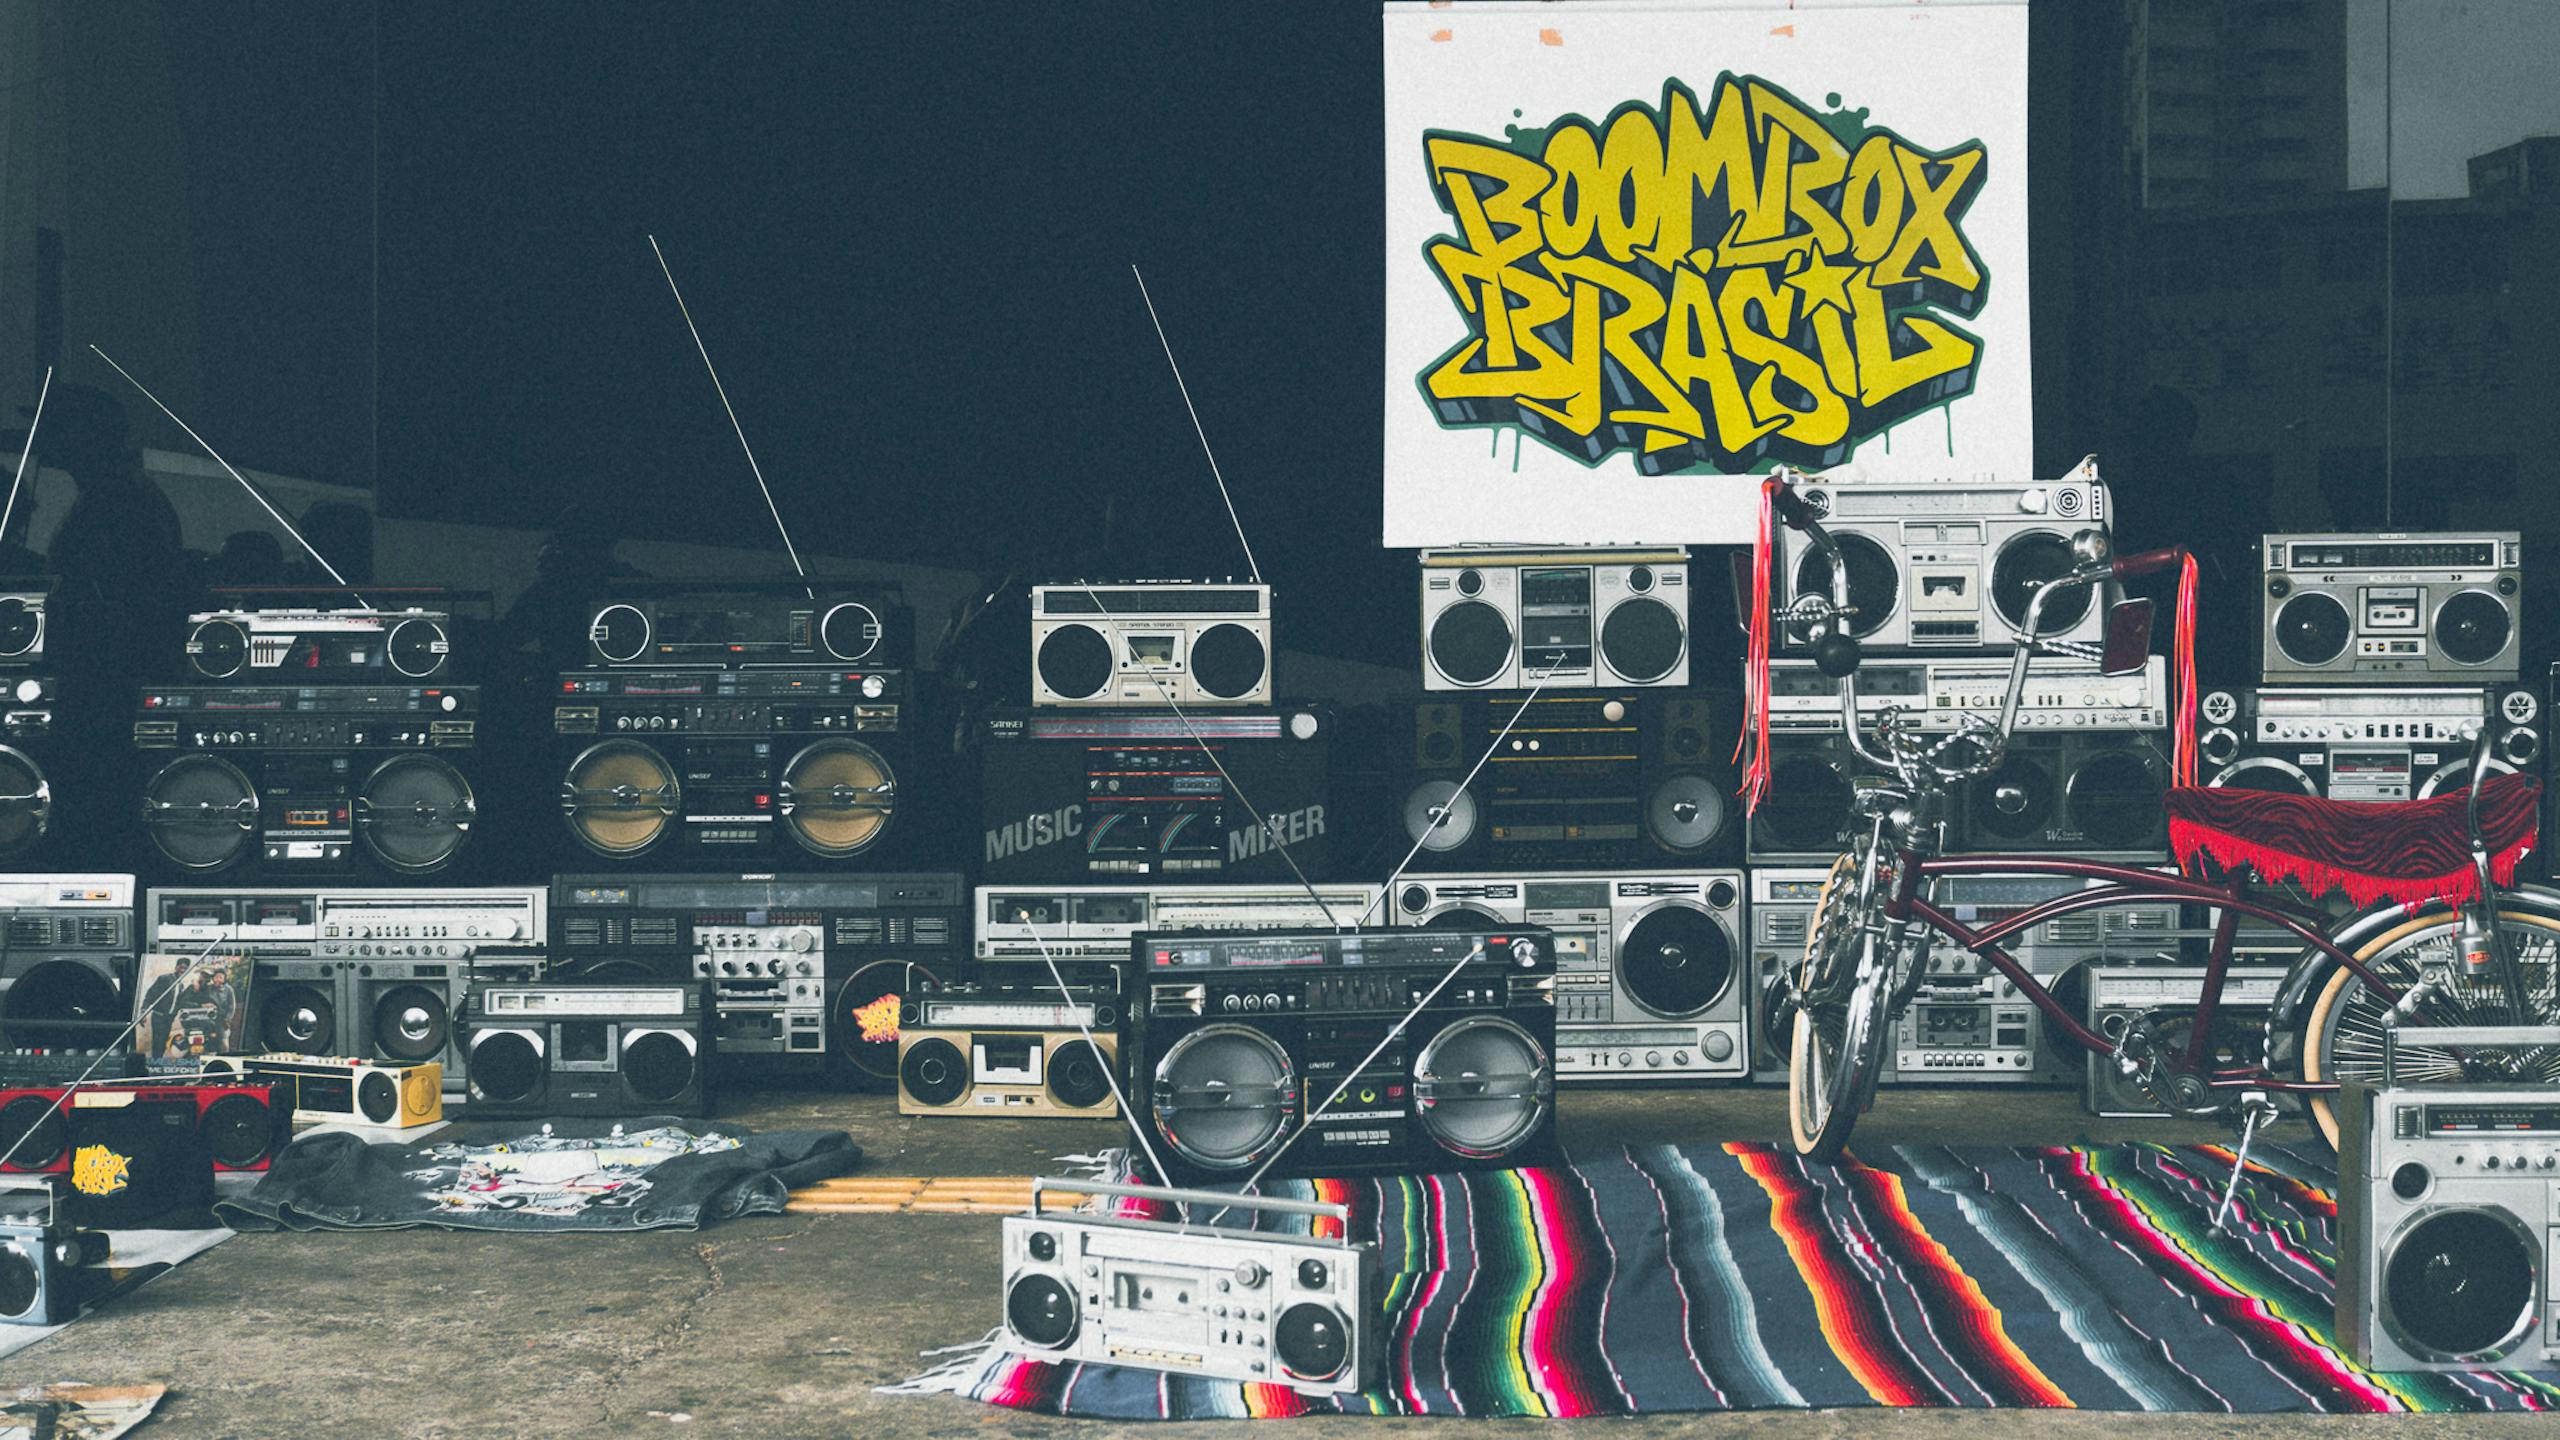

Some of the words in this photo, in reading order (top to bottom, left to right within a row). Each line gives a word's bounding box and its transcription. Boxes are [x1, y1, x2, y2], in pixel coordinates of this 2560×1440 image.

[1426, 76, 1985, 292] BOOMBOX
[1424, 243, 1982, 456] BRASIL
[990, 720, 1024, 729] SANKEI
[986, 804, 1083, 863] MUSIC
[1142, 815, 1148, 825] 1
[1214, 815, 1222, 825] 2
[1229, 804, 1325, 863] MIXER
